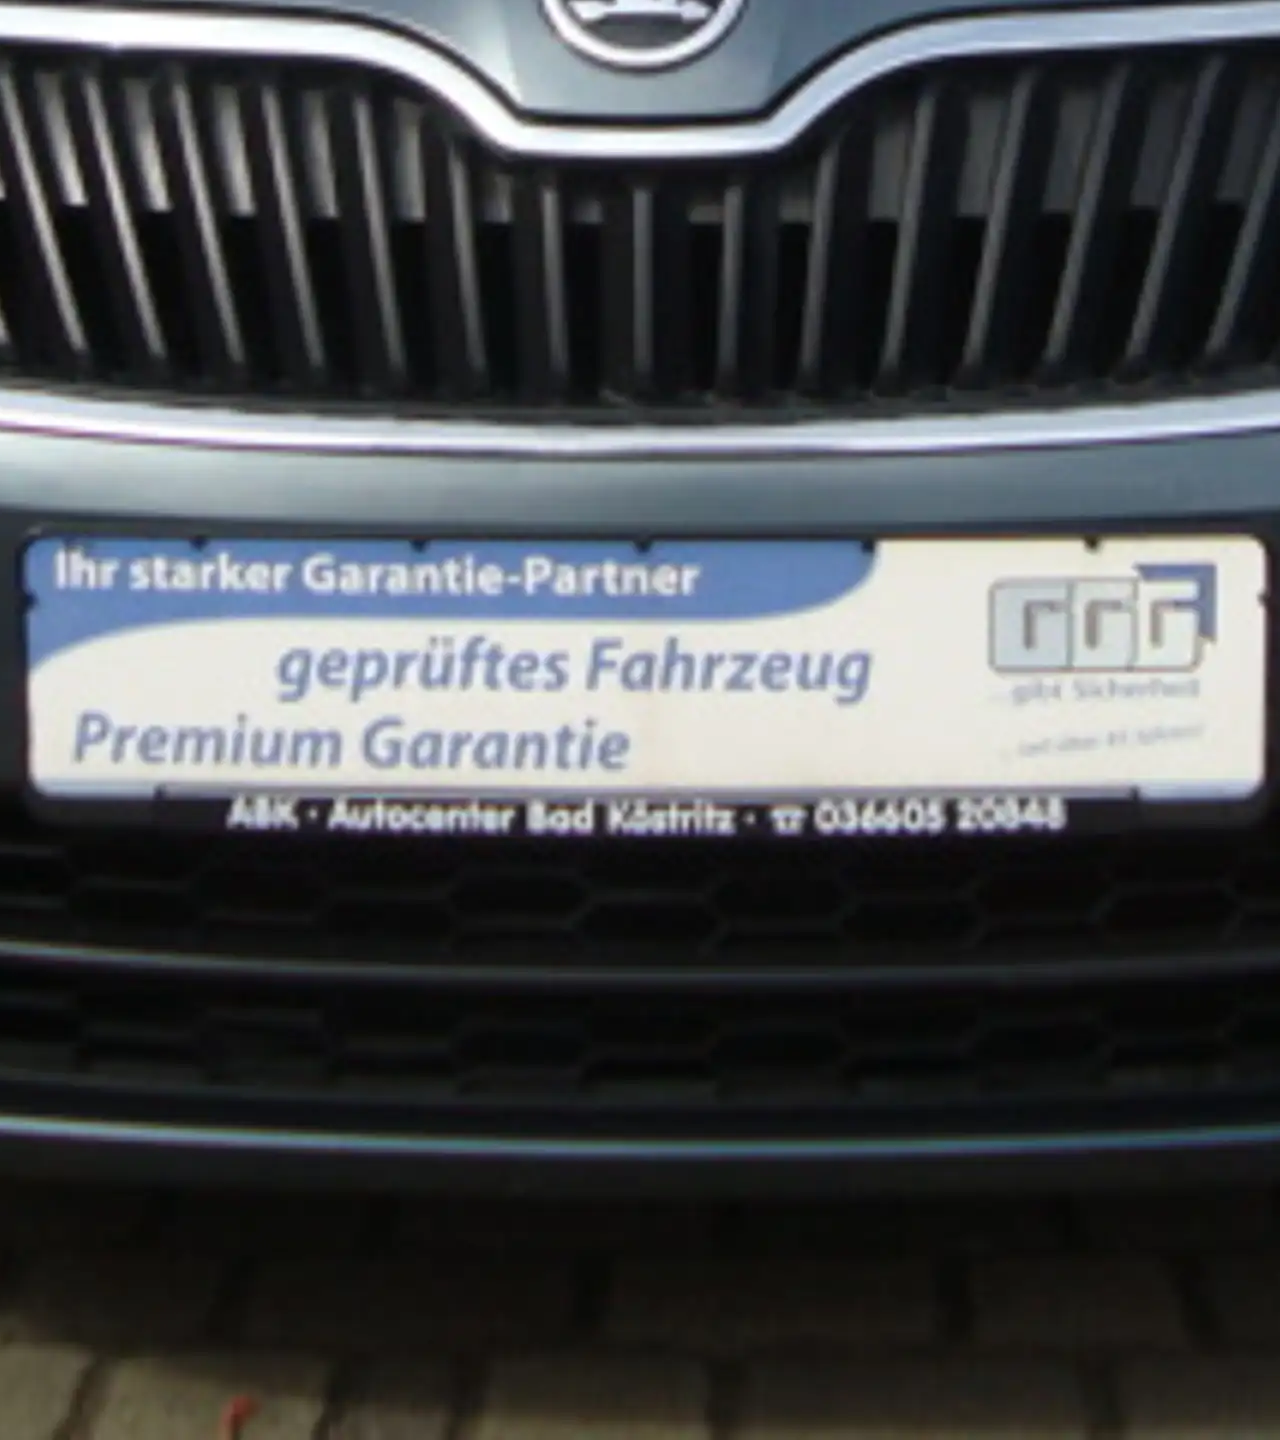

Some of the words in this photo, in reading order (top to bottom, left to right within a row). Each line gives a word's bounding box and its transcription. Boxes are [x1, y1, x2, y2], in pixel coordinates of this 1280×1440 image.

[52, 548, 116, 592] Ihr
[129, 550, 288, 593] starker
[302, 550, 700, 598] Garantie-Partner
[276, 634, 570, 703] geprüftes
[584, 636, 872, 706] Fahrzeug
[72, 710, 343, 768] Premium
[361, 714, 631, 773] Garantie
[226, 795, 299, 830] ABK
[328, 795, 516, 833] Autocenter
[527, 797, 594, 834] Bad
[607, 796, 736, 836] Köstritz
